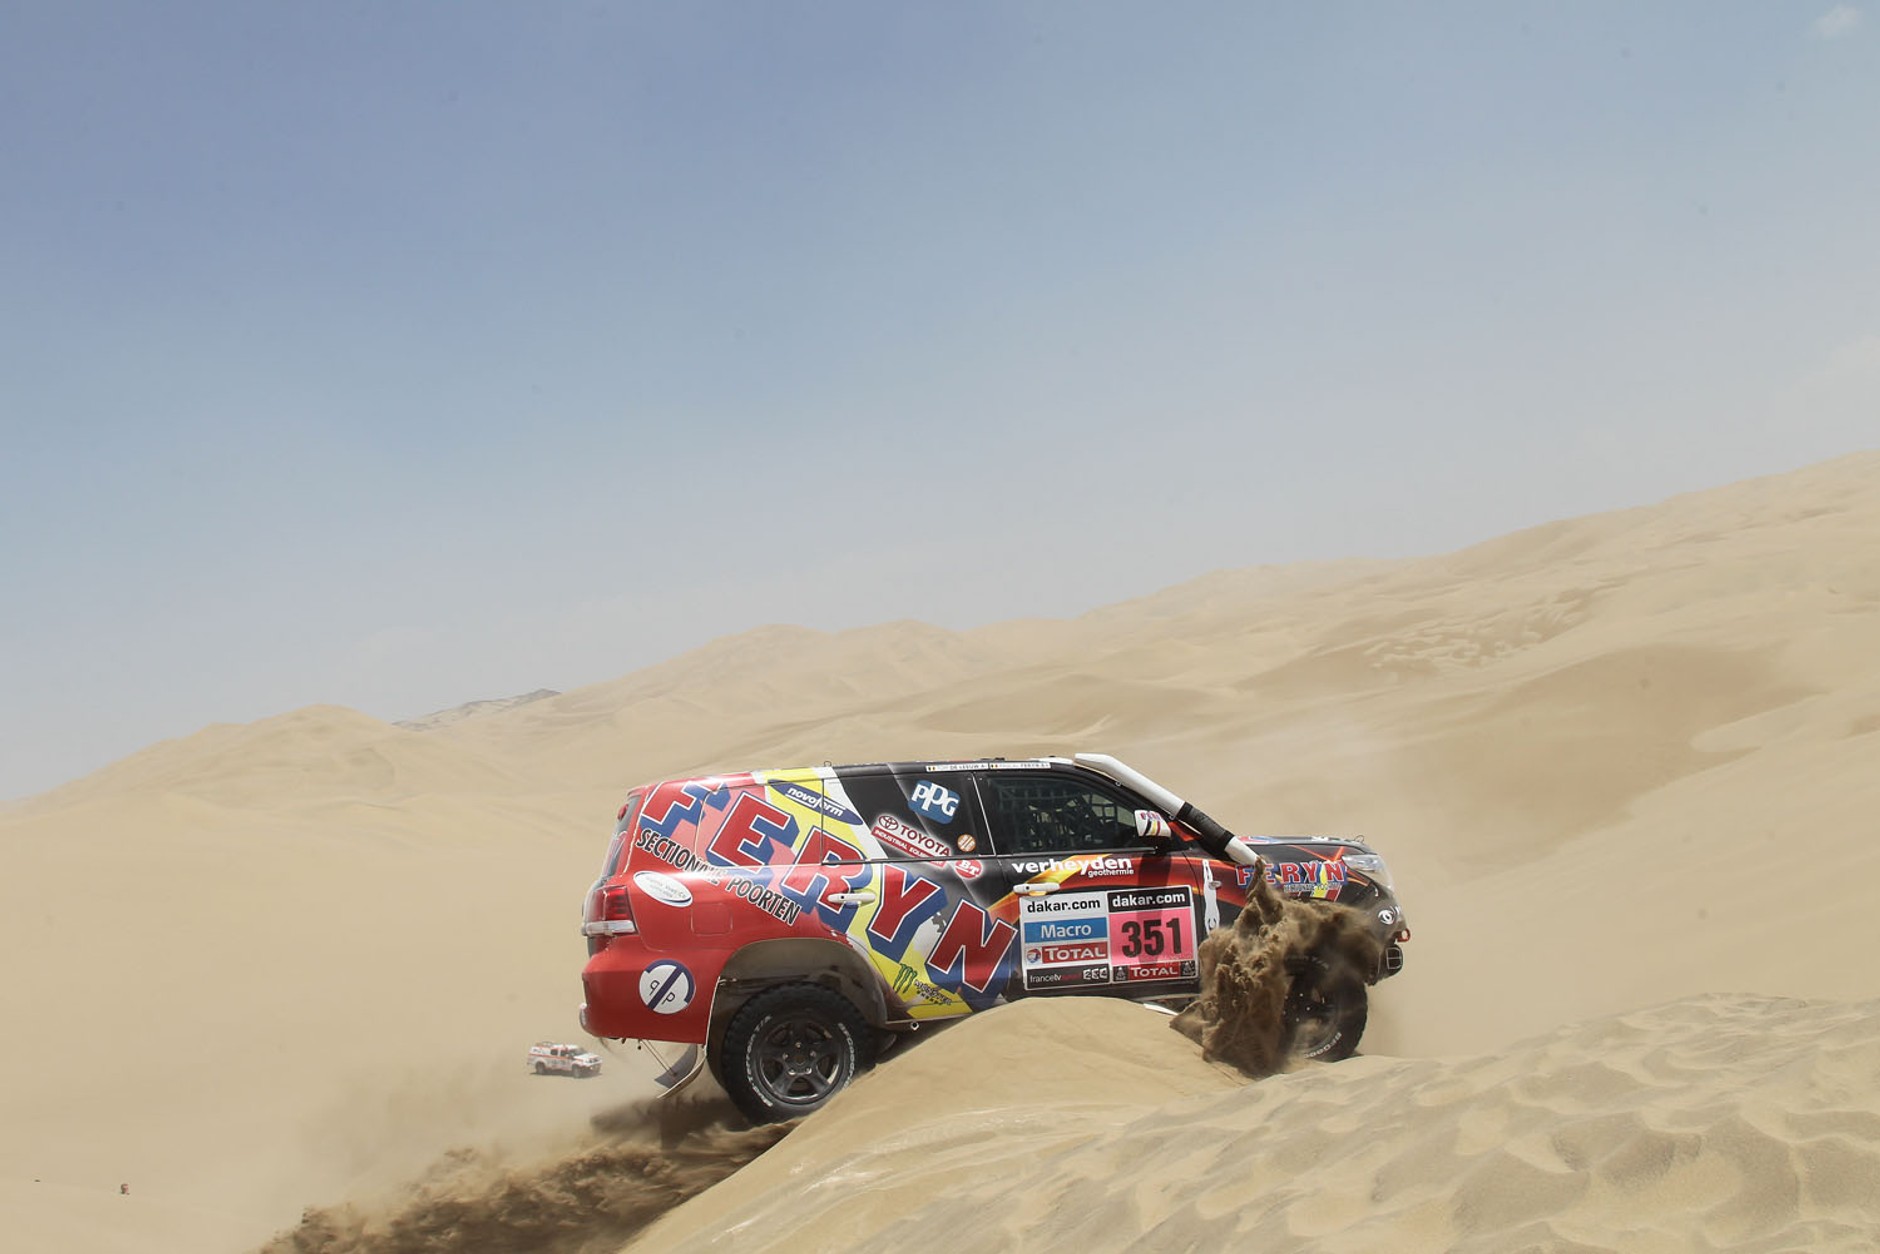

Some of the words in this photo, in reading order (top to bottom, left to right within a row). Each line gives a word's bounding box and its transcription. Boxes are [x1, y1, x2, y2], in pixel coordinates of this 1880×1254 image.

[911, 782, 959, 817] PPG
[900, 825, 951, 857] TOYOTA
[1012, 856, 1132, 875] verheyden
[1088, 868, 1134, 878] geothermie
[1236, 860, 1346, 886] FERYN
[640, 780, 1018, 994] FERYN
[726, 876, 801, 926] POORTEN
[1027, 899, 1101, 914] dakar.com
[1112, 892, 1186, 908] dakar.com
[1041, 924, 1092, 939] Macro
[1121, 917, 1182, 958] 351
[1045, 947, 1106, 961] TOTAL
[1131, 965, 1178, 977] TOTAL
